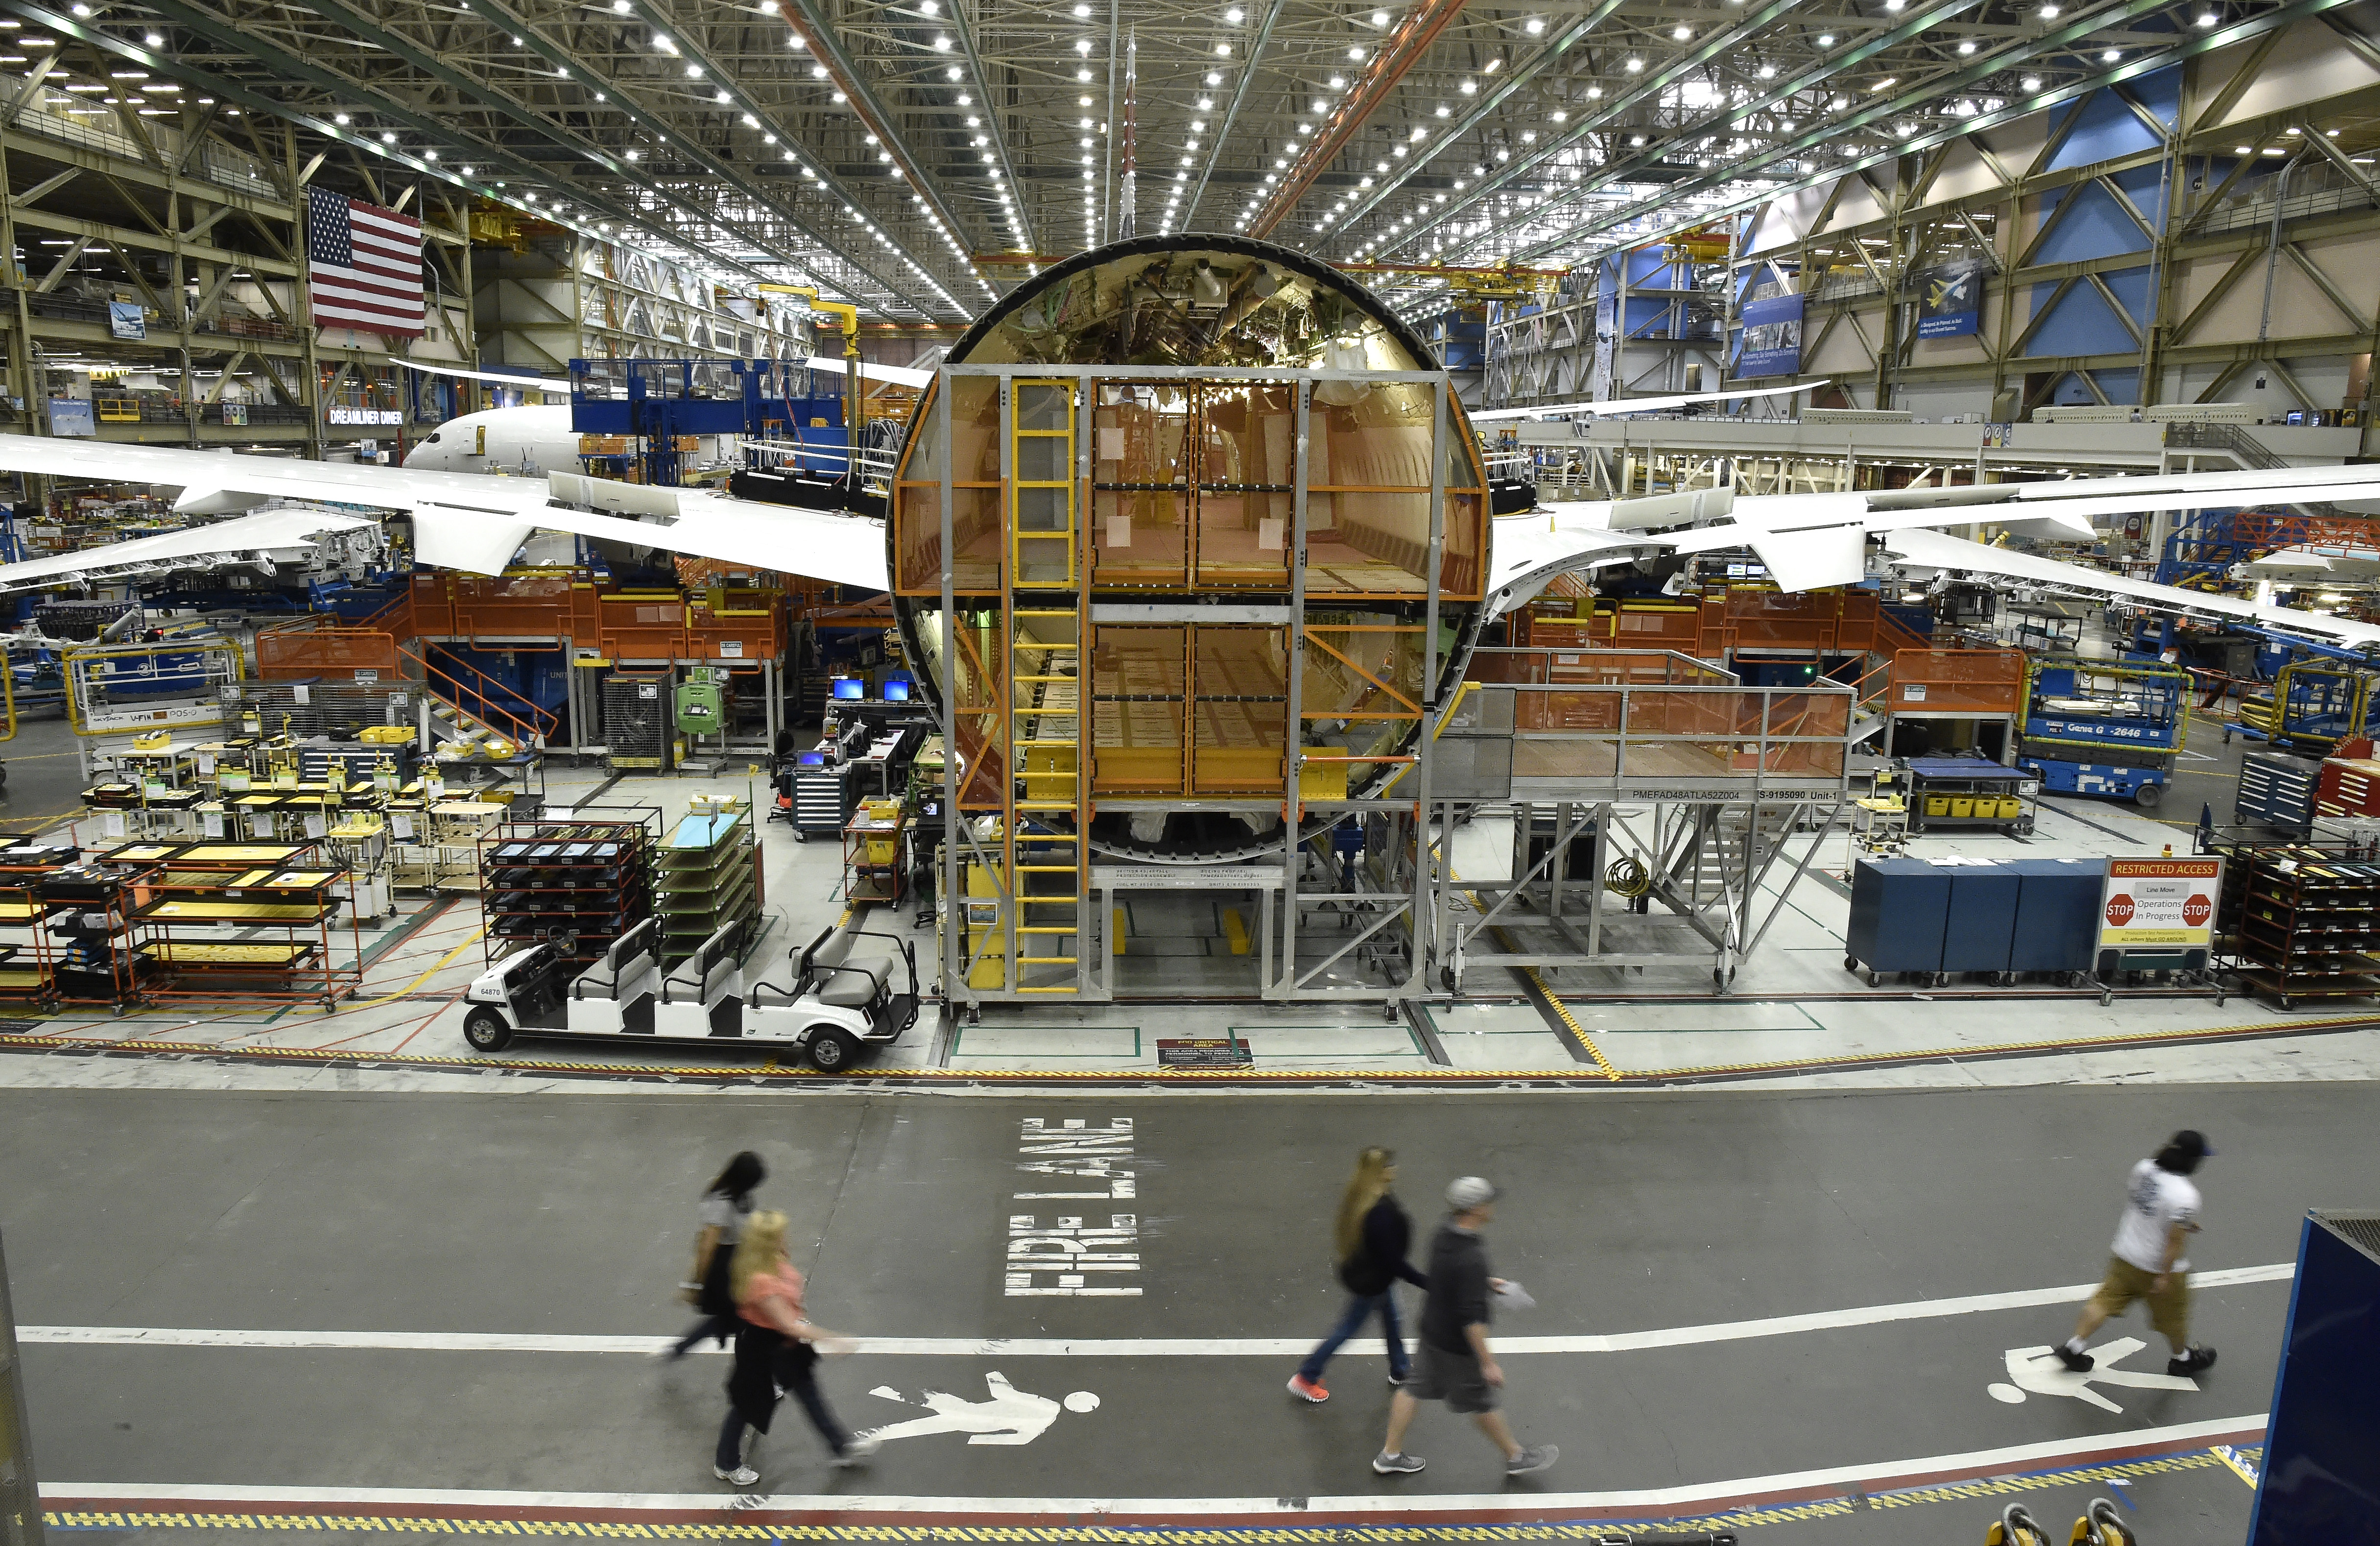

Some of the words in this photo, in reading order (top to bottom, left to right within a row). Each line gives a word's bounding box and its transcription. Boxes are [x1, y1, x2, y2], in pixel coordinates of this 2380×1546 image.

[330, 410, 379, 424] DREAMLINER
[381, 411, 403, 425] DINER
[2068, 724, 2093, 733] Genie
[1632, 791, 1739, 799] PMEFAD48ATLA52Z004
[1810, 792, 1837, 800] Unit-1
[2116, 865, 2174, 874] RESTRICTED
[2176, 865, 2213, 874] ACCESS
[2137, 900, 2182, 909] Operations
[2107, 905, 2134, 916] STOP
[2183, 905, 2210, 916] STOP
[2145, 912, 2180, 921] Progress
[1013, 1117, 1136, 1199] LANE
[1004, 1214, 1143, 1296] FIRE
